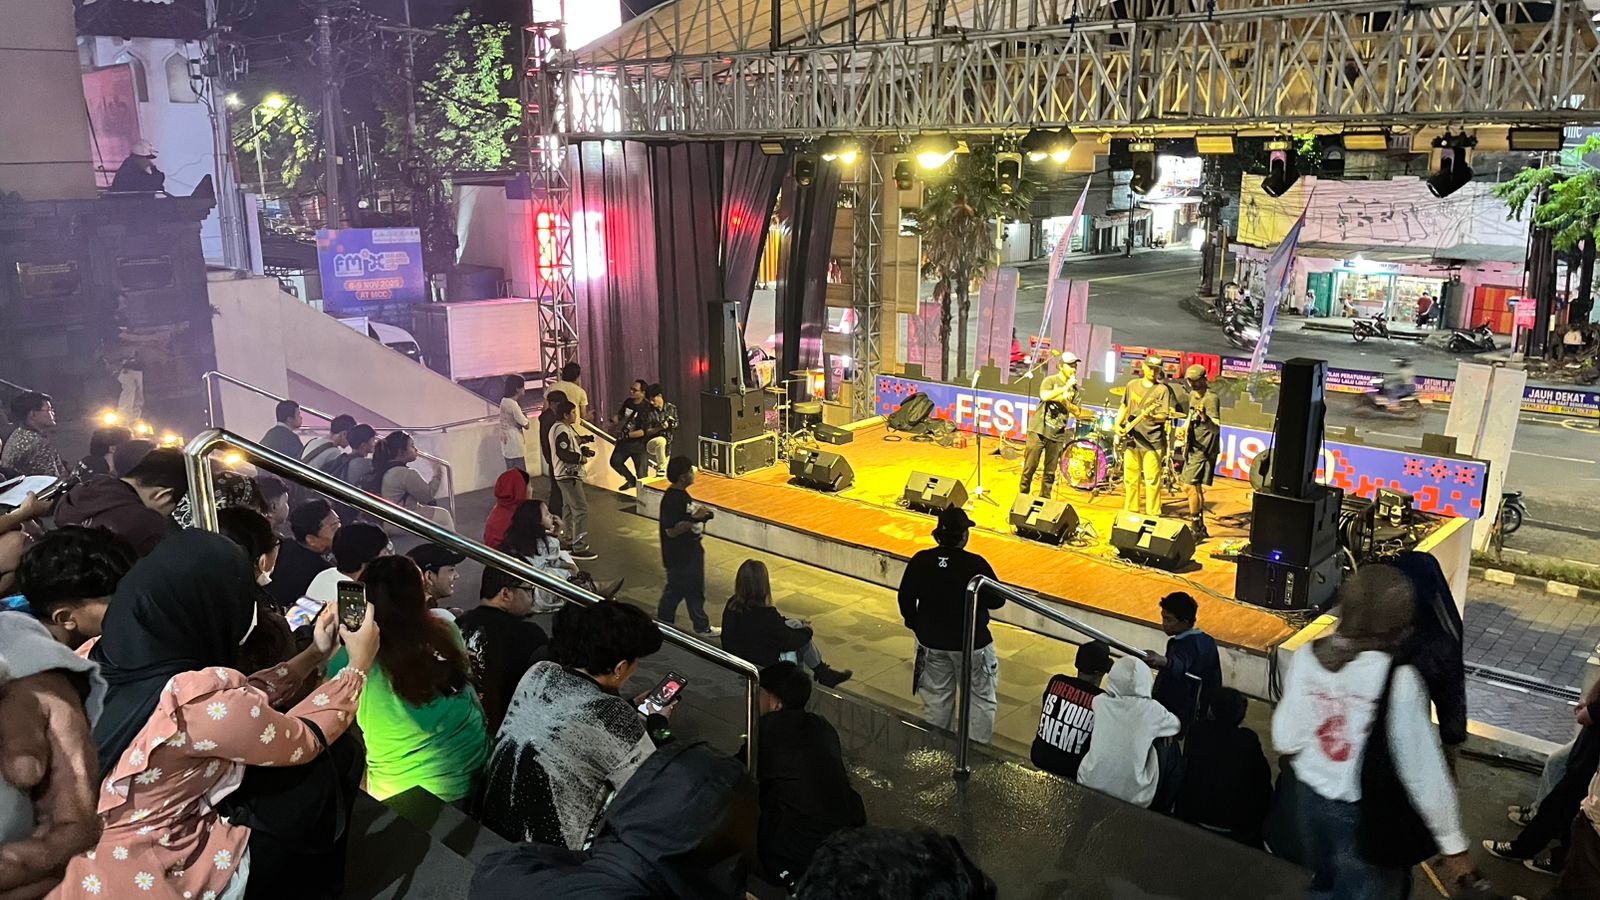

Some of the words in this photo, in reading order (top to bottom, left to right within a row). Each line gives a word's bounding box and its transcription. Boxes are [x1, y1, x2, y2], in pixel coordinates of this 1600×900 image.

[364, 280, 379, 289] NOV
[360, 291, 370, 299] AT
[370, 290, 390, 299] MCC
[1528, 389, 1554, 400] JAUH
[1555, 391, 1586, 403] DEKAT
[1043, 693, 1058, 715] IS
[1057, 698, 1094, 732] YOUR
[1038, 713, 1090, 754] ENEMY
